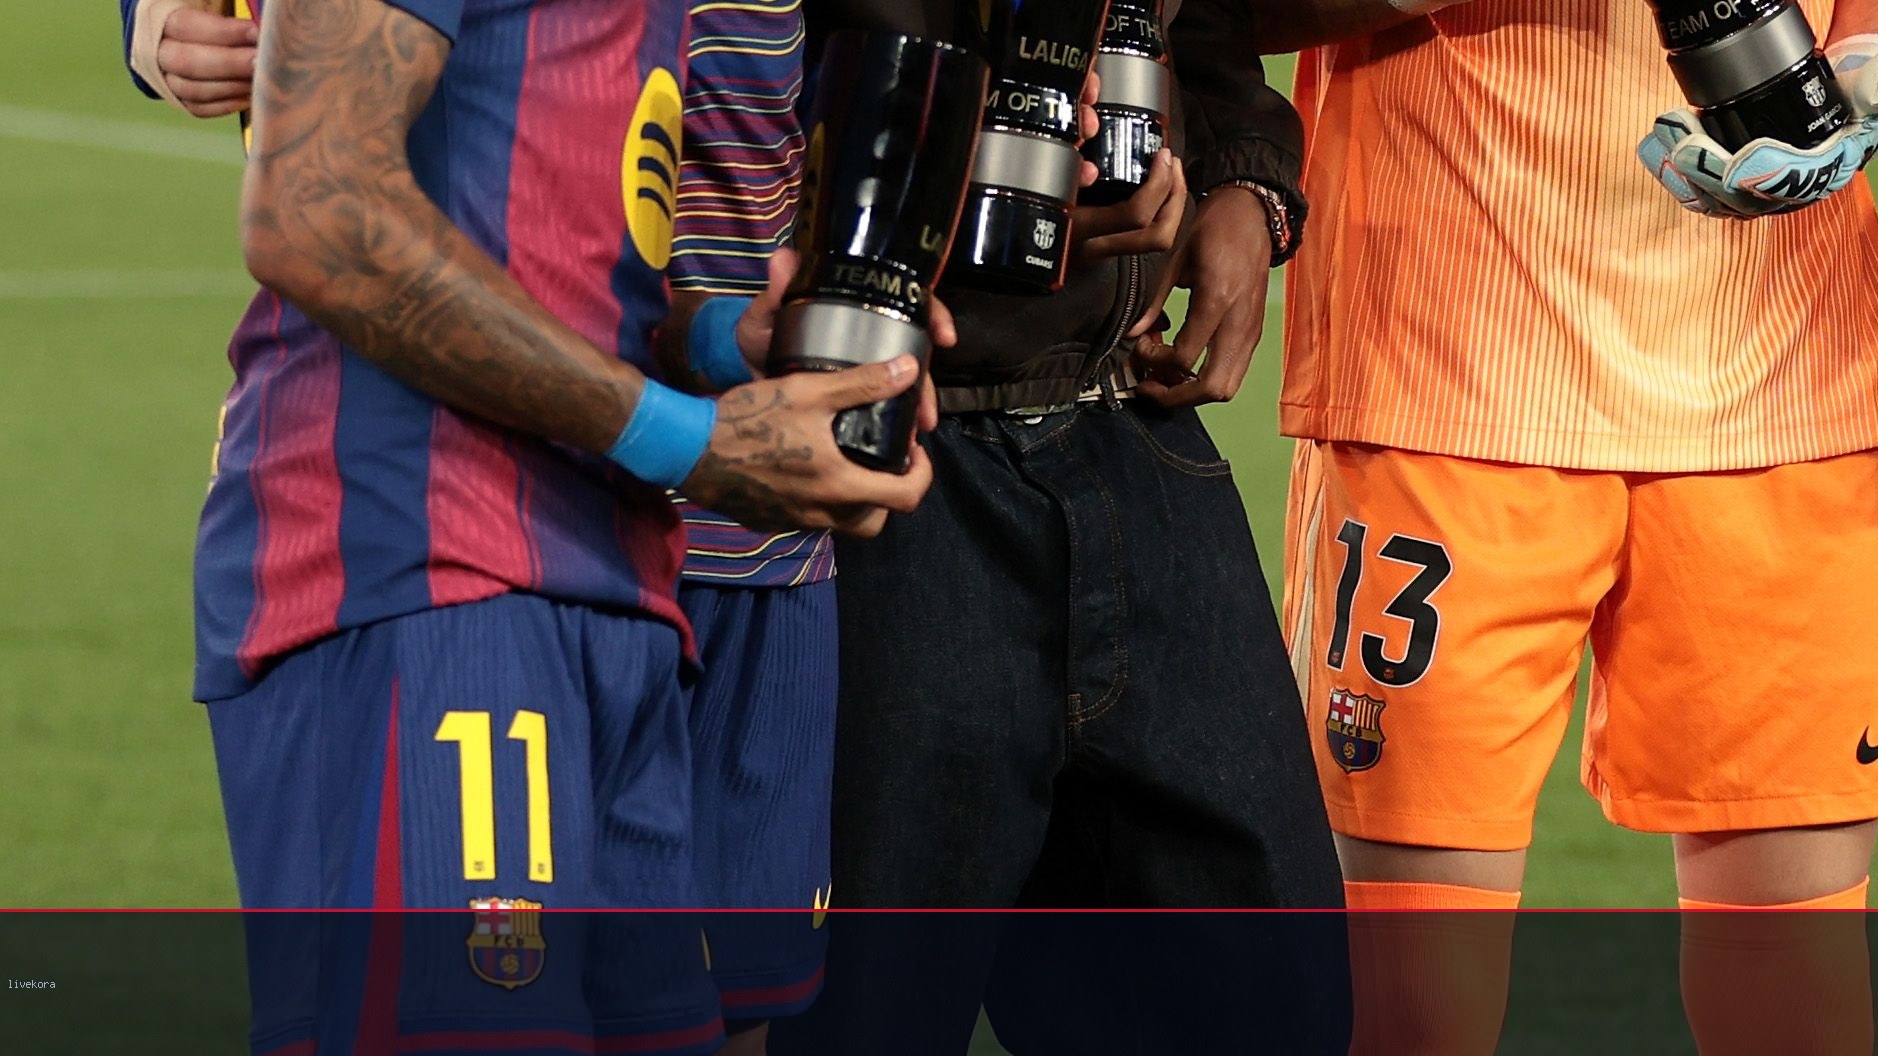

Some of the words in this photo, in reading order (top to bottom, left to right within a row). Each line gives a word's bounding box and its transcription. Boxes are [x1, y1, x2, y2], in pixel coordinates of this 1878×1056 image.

[1007, 92, 1041, 113] OF
[835, 263, 902, 296] TEAM
[1326, 517, 1454, 688] 13
[434, 709, 554, 883] 11
